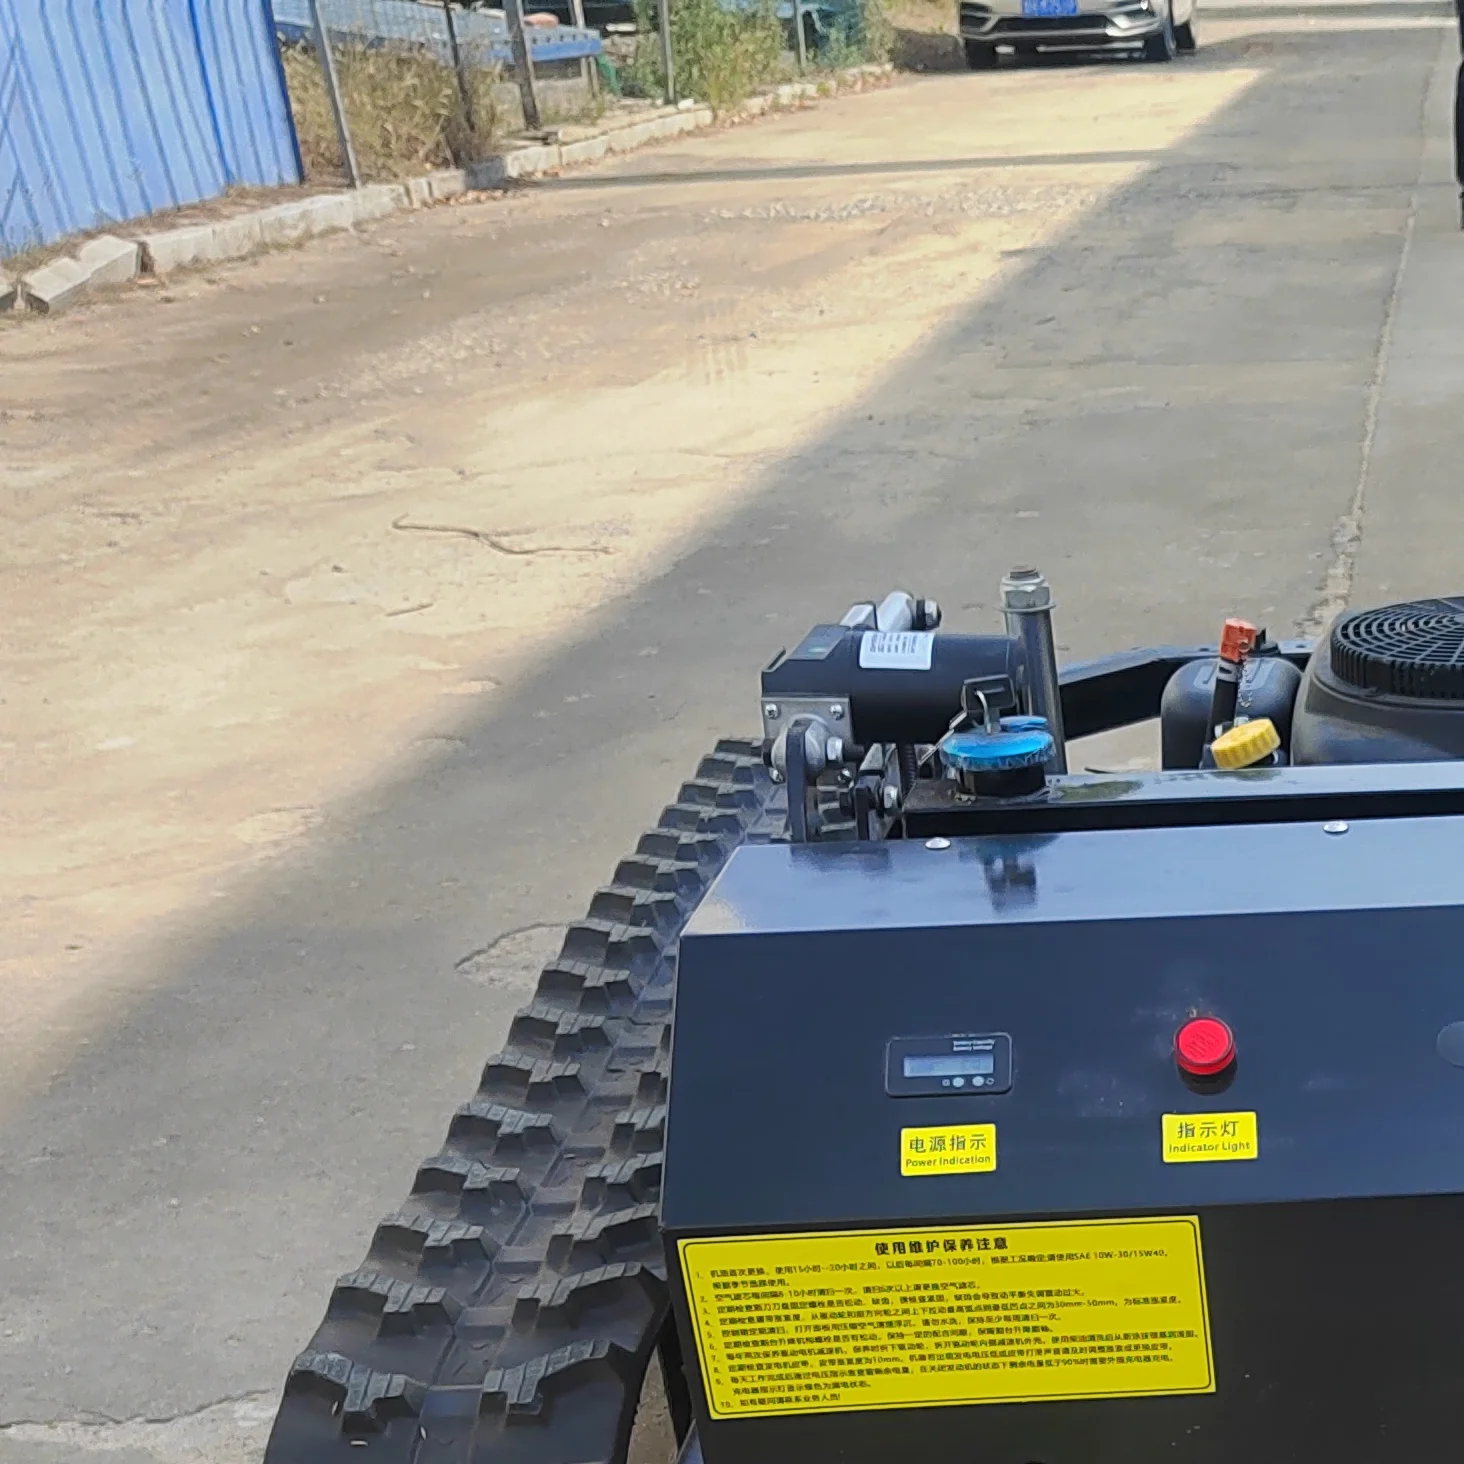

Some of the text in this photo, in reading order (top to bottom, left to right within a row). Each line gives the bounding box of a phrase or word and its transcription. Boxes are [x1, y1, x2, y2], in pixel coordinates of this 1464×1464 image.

[1177, 1119, 1239, 1139] 指示灯
[908, 1133, 987, 1154] 电源指示
[1168, 1140, 1251, 1154] Indicator Light
[905, 1154, 991, 1168] Power Indication
[873, 1235, 1008, 1256] 使用维护保养注意
